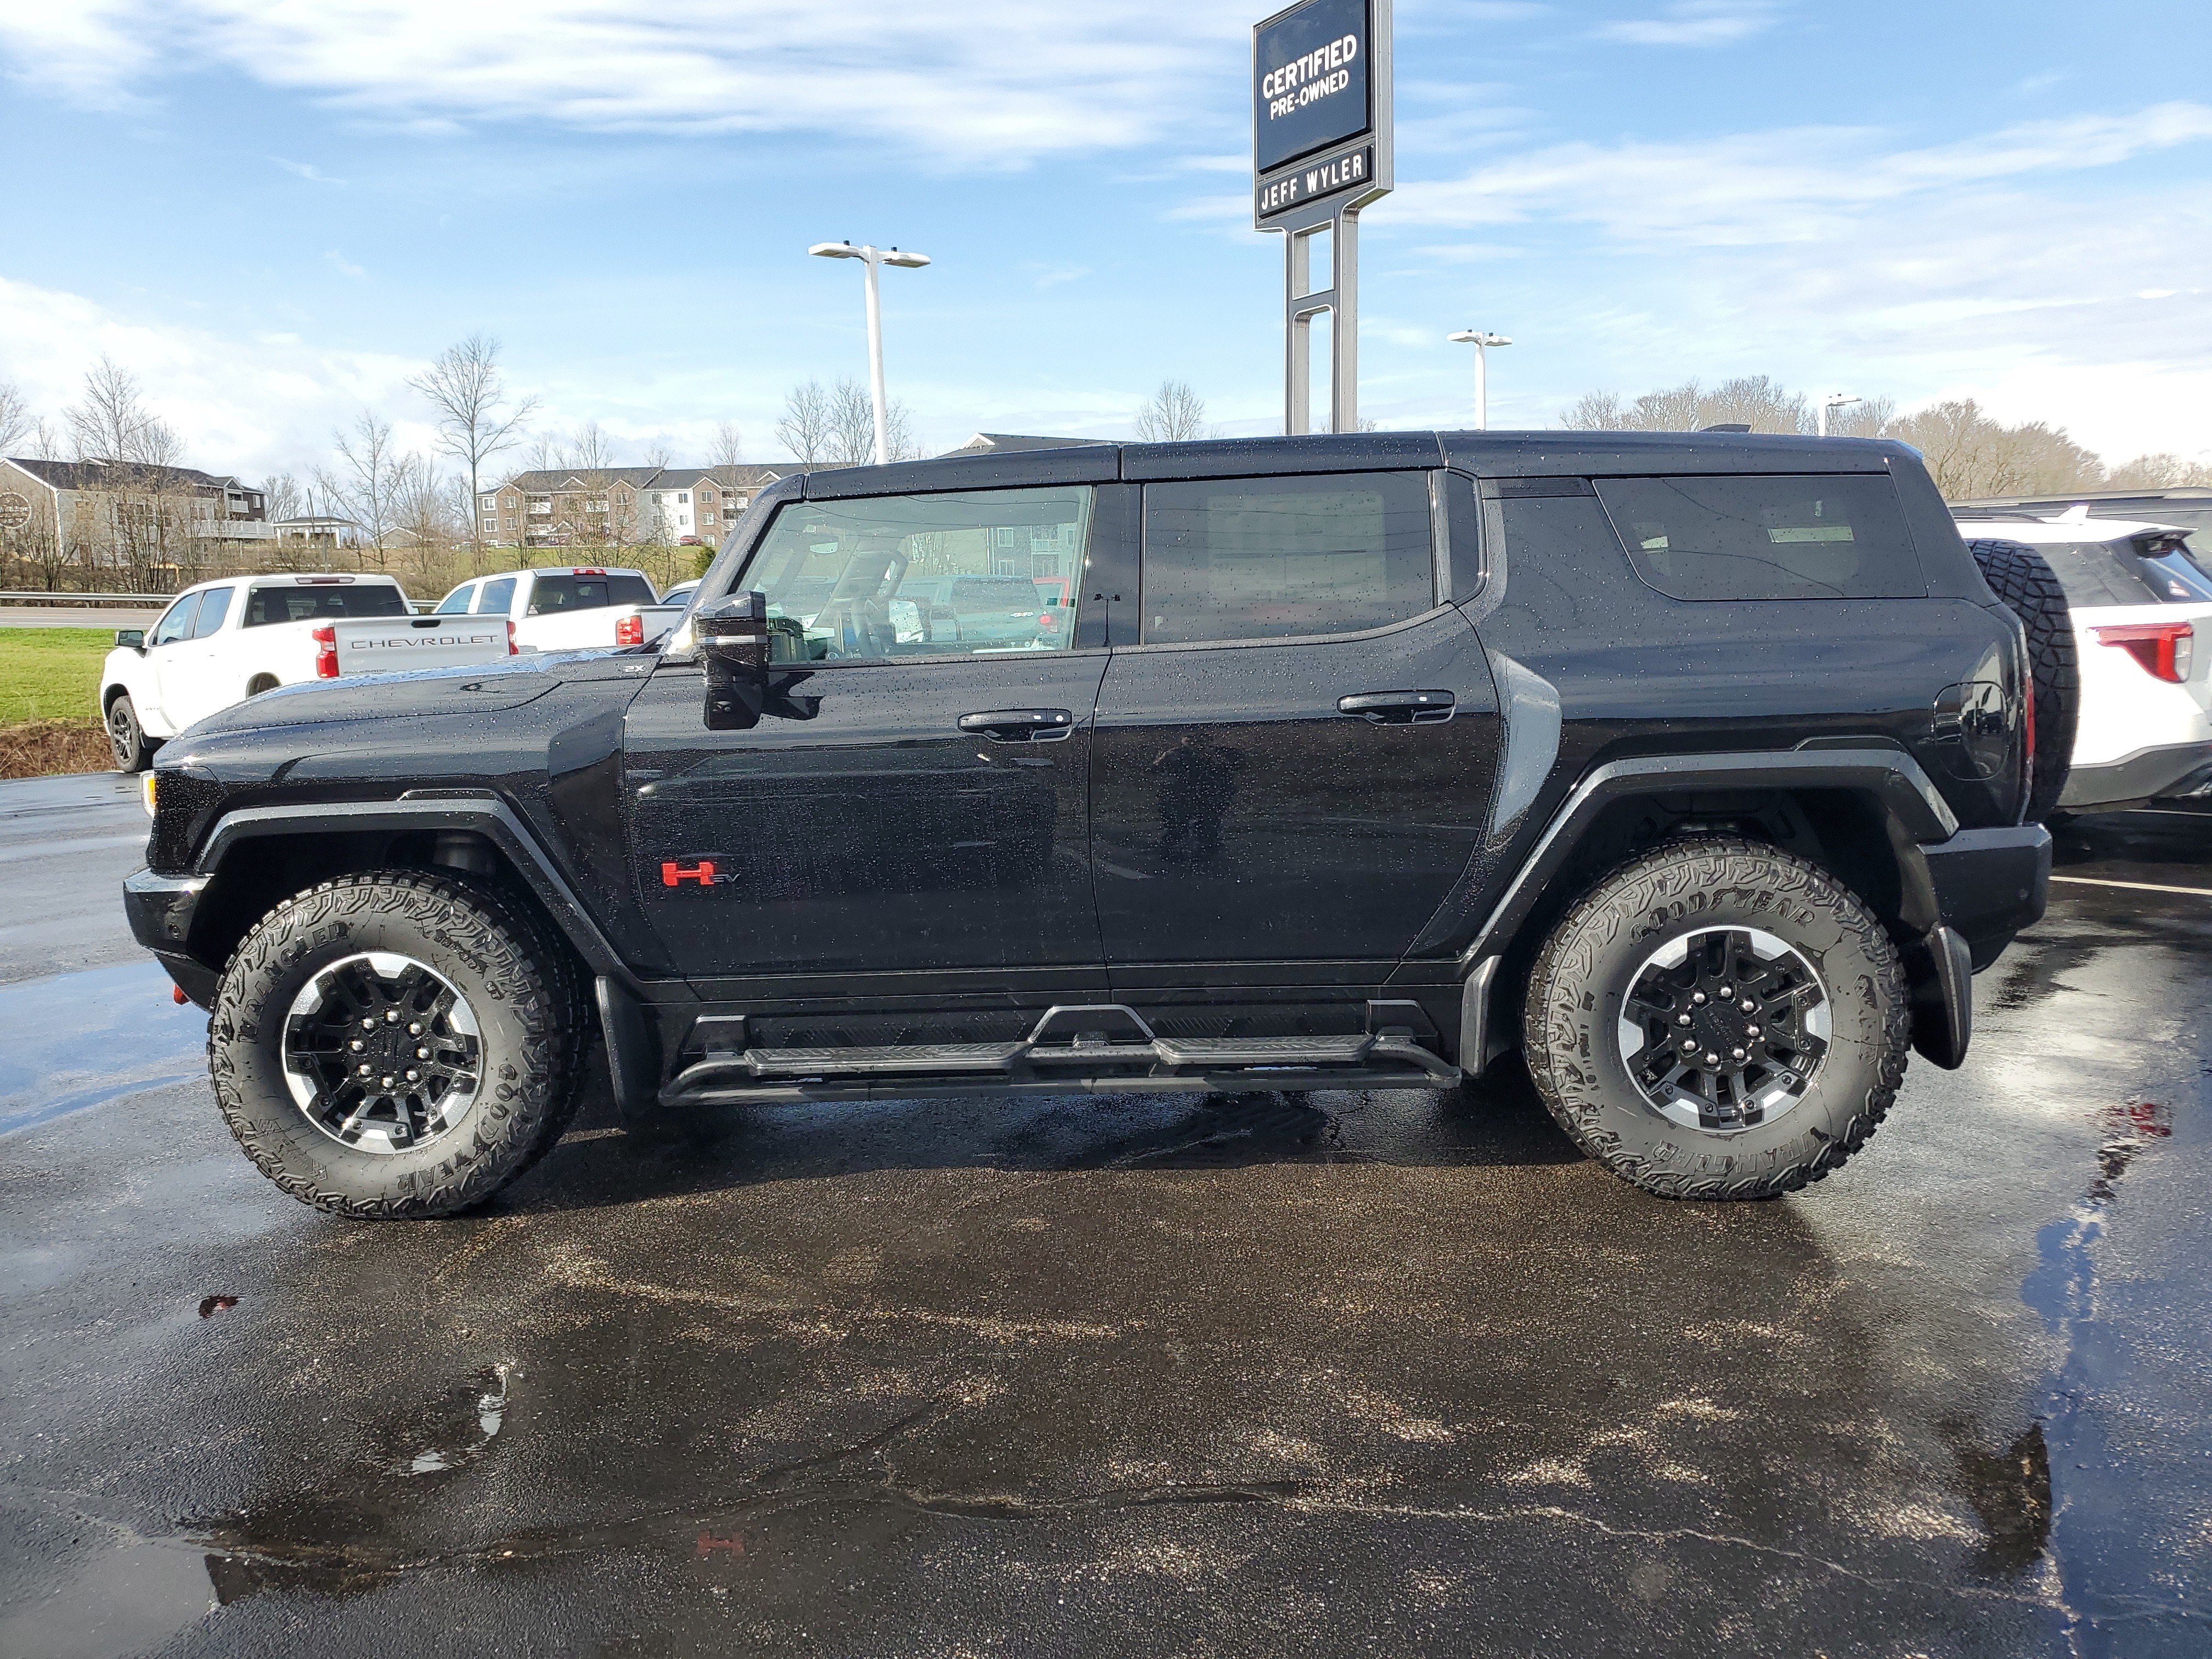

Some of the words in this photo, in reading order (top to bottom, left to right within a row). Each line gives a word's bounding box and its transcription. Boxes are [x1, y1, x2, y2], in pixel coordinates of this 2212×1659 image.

[1263, 35, 1357, 99] CERTIFIED
[1270, 69, 1349, 120] PRE-OWNED
[1261, 178, 1297, 210] JEFF
[1306, 155, 1362, 193] WYLER
[351, 635, 498, 649] CHEVROLET
[1629, 887, 1815, 944] GOODYEAR
[236, 920, 351, 1043] WRANGLER
[397, 1063, 518, 1195] GOODYEAR
[1652, 1126, 1831, 1176] WRANGLER
